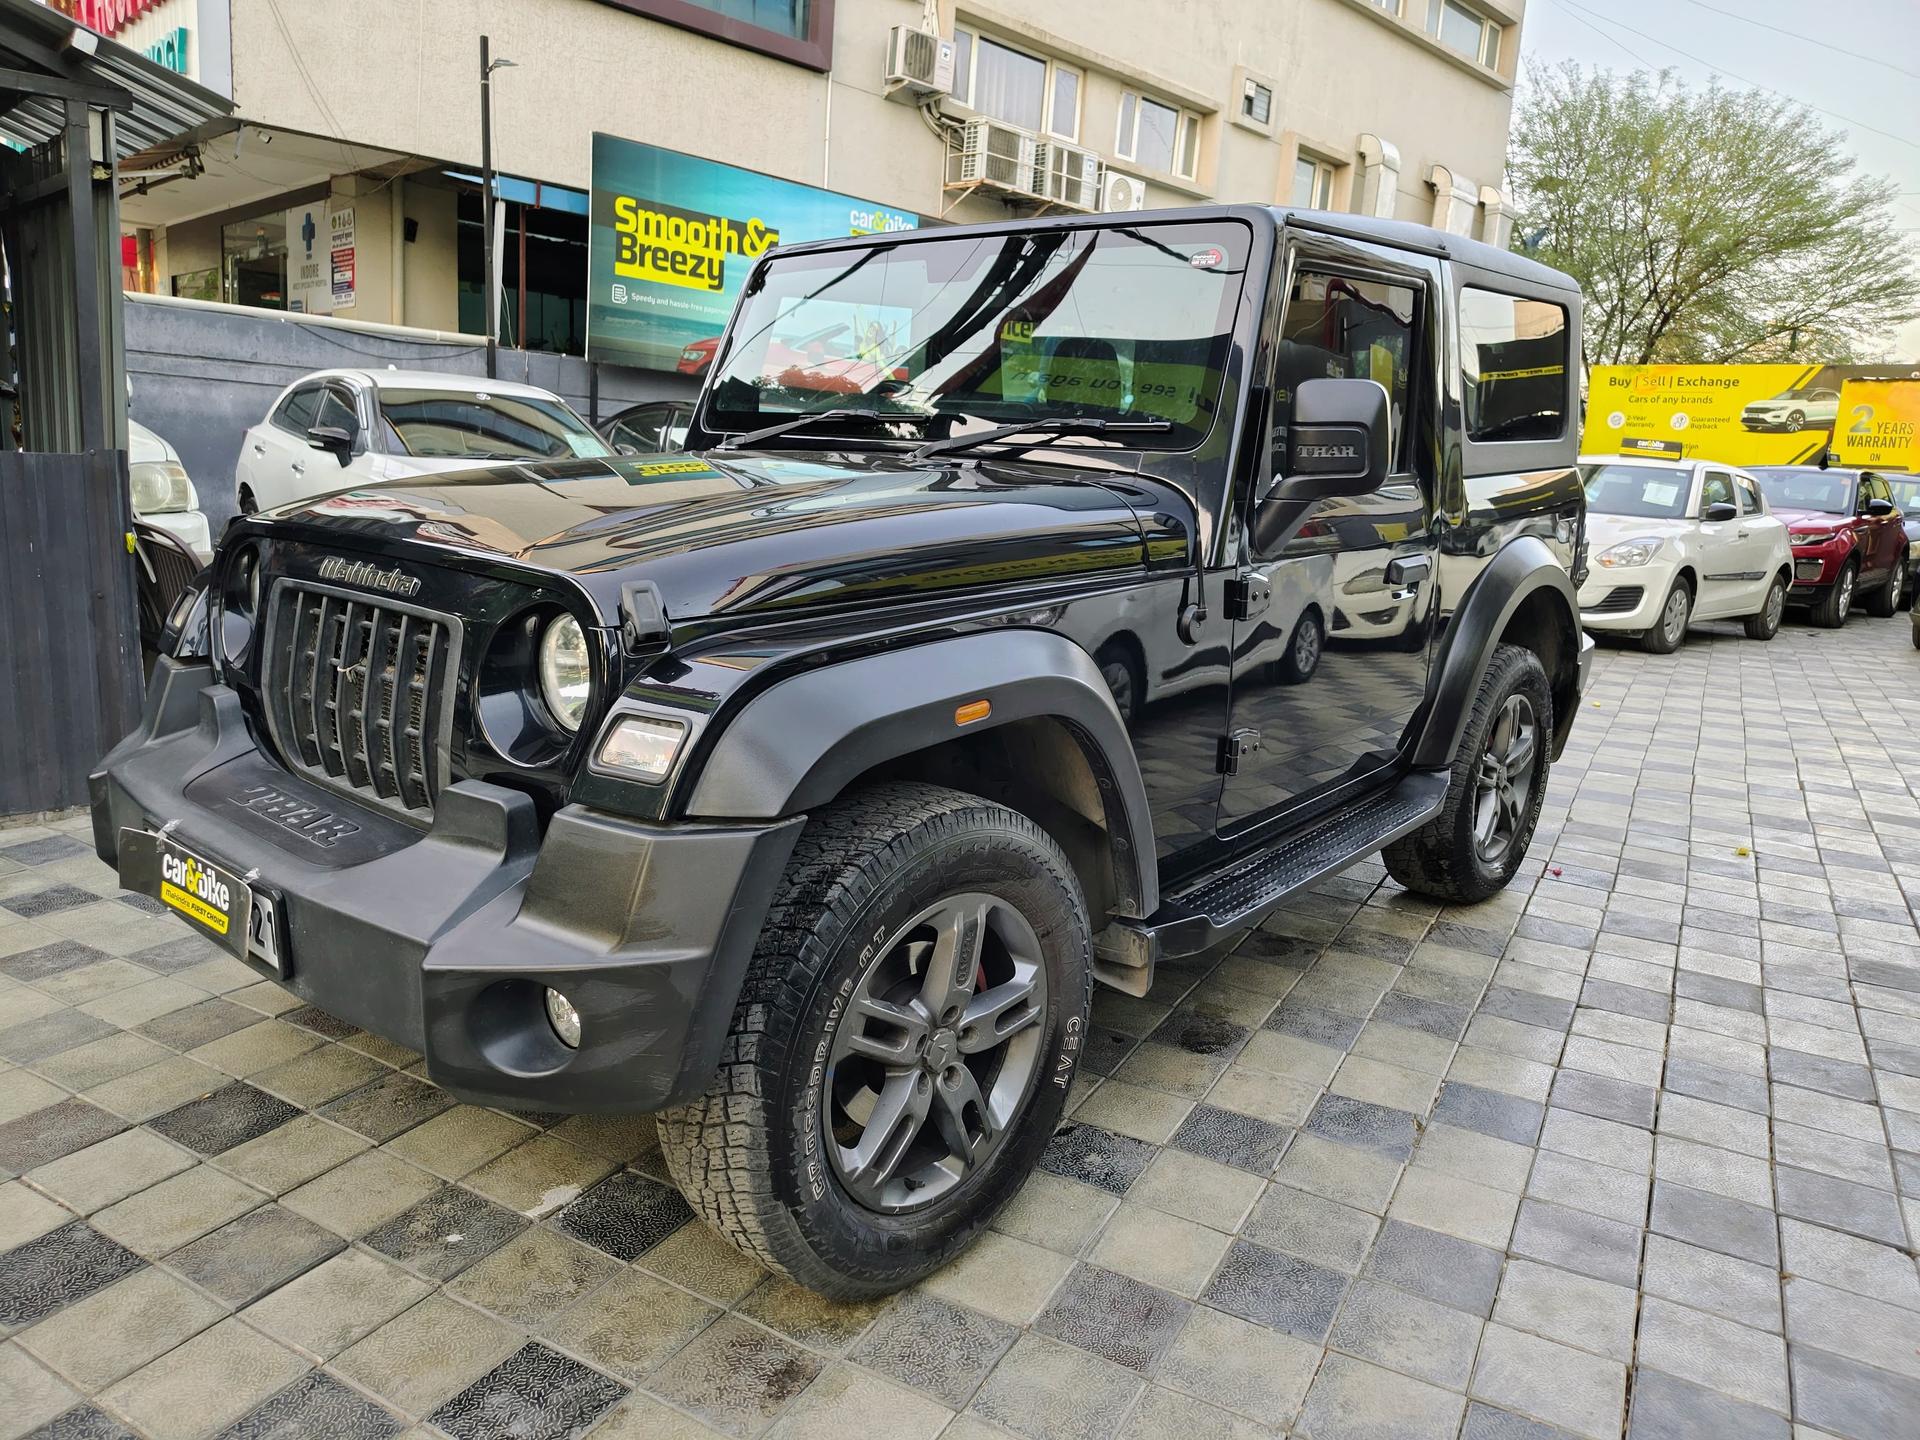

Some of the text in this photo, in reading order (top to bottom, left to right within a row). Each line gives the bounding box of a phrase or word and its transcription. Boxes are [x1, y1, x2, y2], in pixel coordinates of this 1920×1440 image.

[614, 196, 779, 257] Smooth &
[616, 231, 725, 291] Breezy
[631, 293, 656, 305] Speedy
[656, 297, 669, 306] and
[1609, 376, 1632, 388] Buy
[1643, 376, 1666, 386] Sell
[1677, 376, 1740, 389] Exchange
[1628, 395, 1713, 405] Cars of any brands
[1849, 404, 1915, 434] 2 YEARS
[1297, 445, 1358, 458] THAR
[1847, 435, 1912, 449] WARRANTY
[1869, 453, 1881, 462] ON
[227, 783, 362, 848] THAR
[163, 853, 230, 912] car&bike
[190, 903, 207, 917] FIRST
[206, 912, 225, 929] CHOICE
[1053, 1016, 1081, 1089] CEAT
